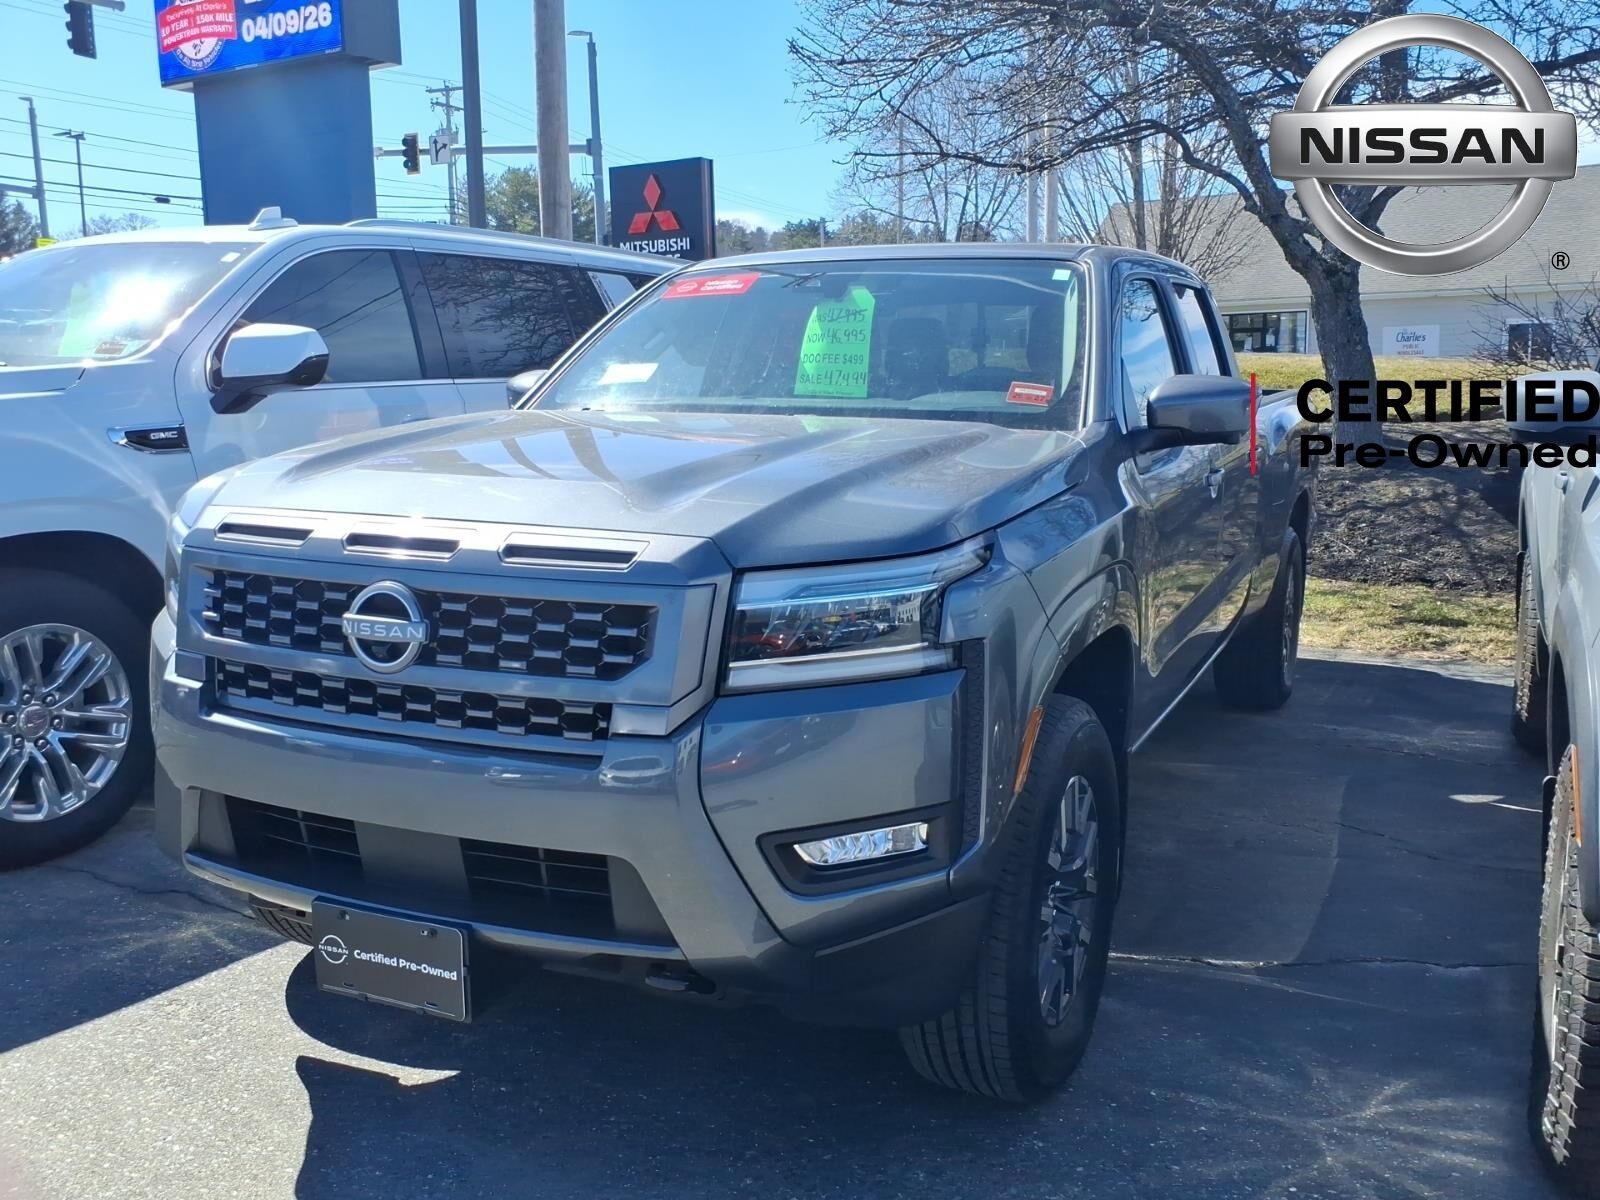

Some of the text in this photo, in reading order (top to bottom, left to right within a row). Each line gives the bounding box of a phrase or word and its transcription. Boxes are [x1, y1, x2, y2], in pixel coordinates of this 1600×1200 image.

[161, 25, 170, 37] 10
[171, 18, 189, 32] YEAR
[215, 12, 234, 23] MILE
[242, 2, 332, 43] 04/09/26
[620, 236, 690, 253] MITSUBISHI
[807, 333, 825, 344] NOW
[802, 353, 864, 365] DOC FEE $499
[800, 374, 823, 384] SALE
[150, 431, 179, 439] GMC
[343, 620, 423, 639] NISSAN
[318, 944, 458, 981] NISSAN Certified Pre-Owned
